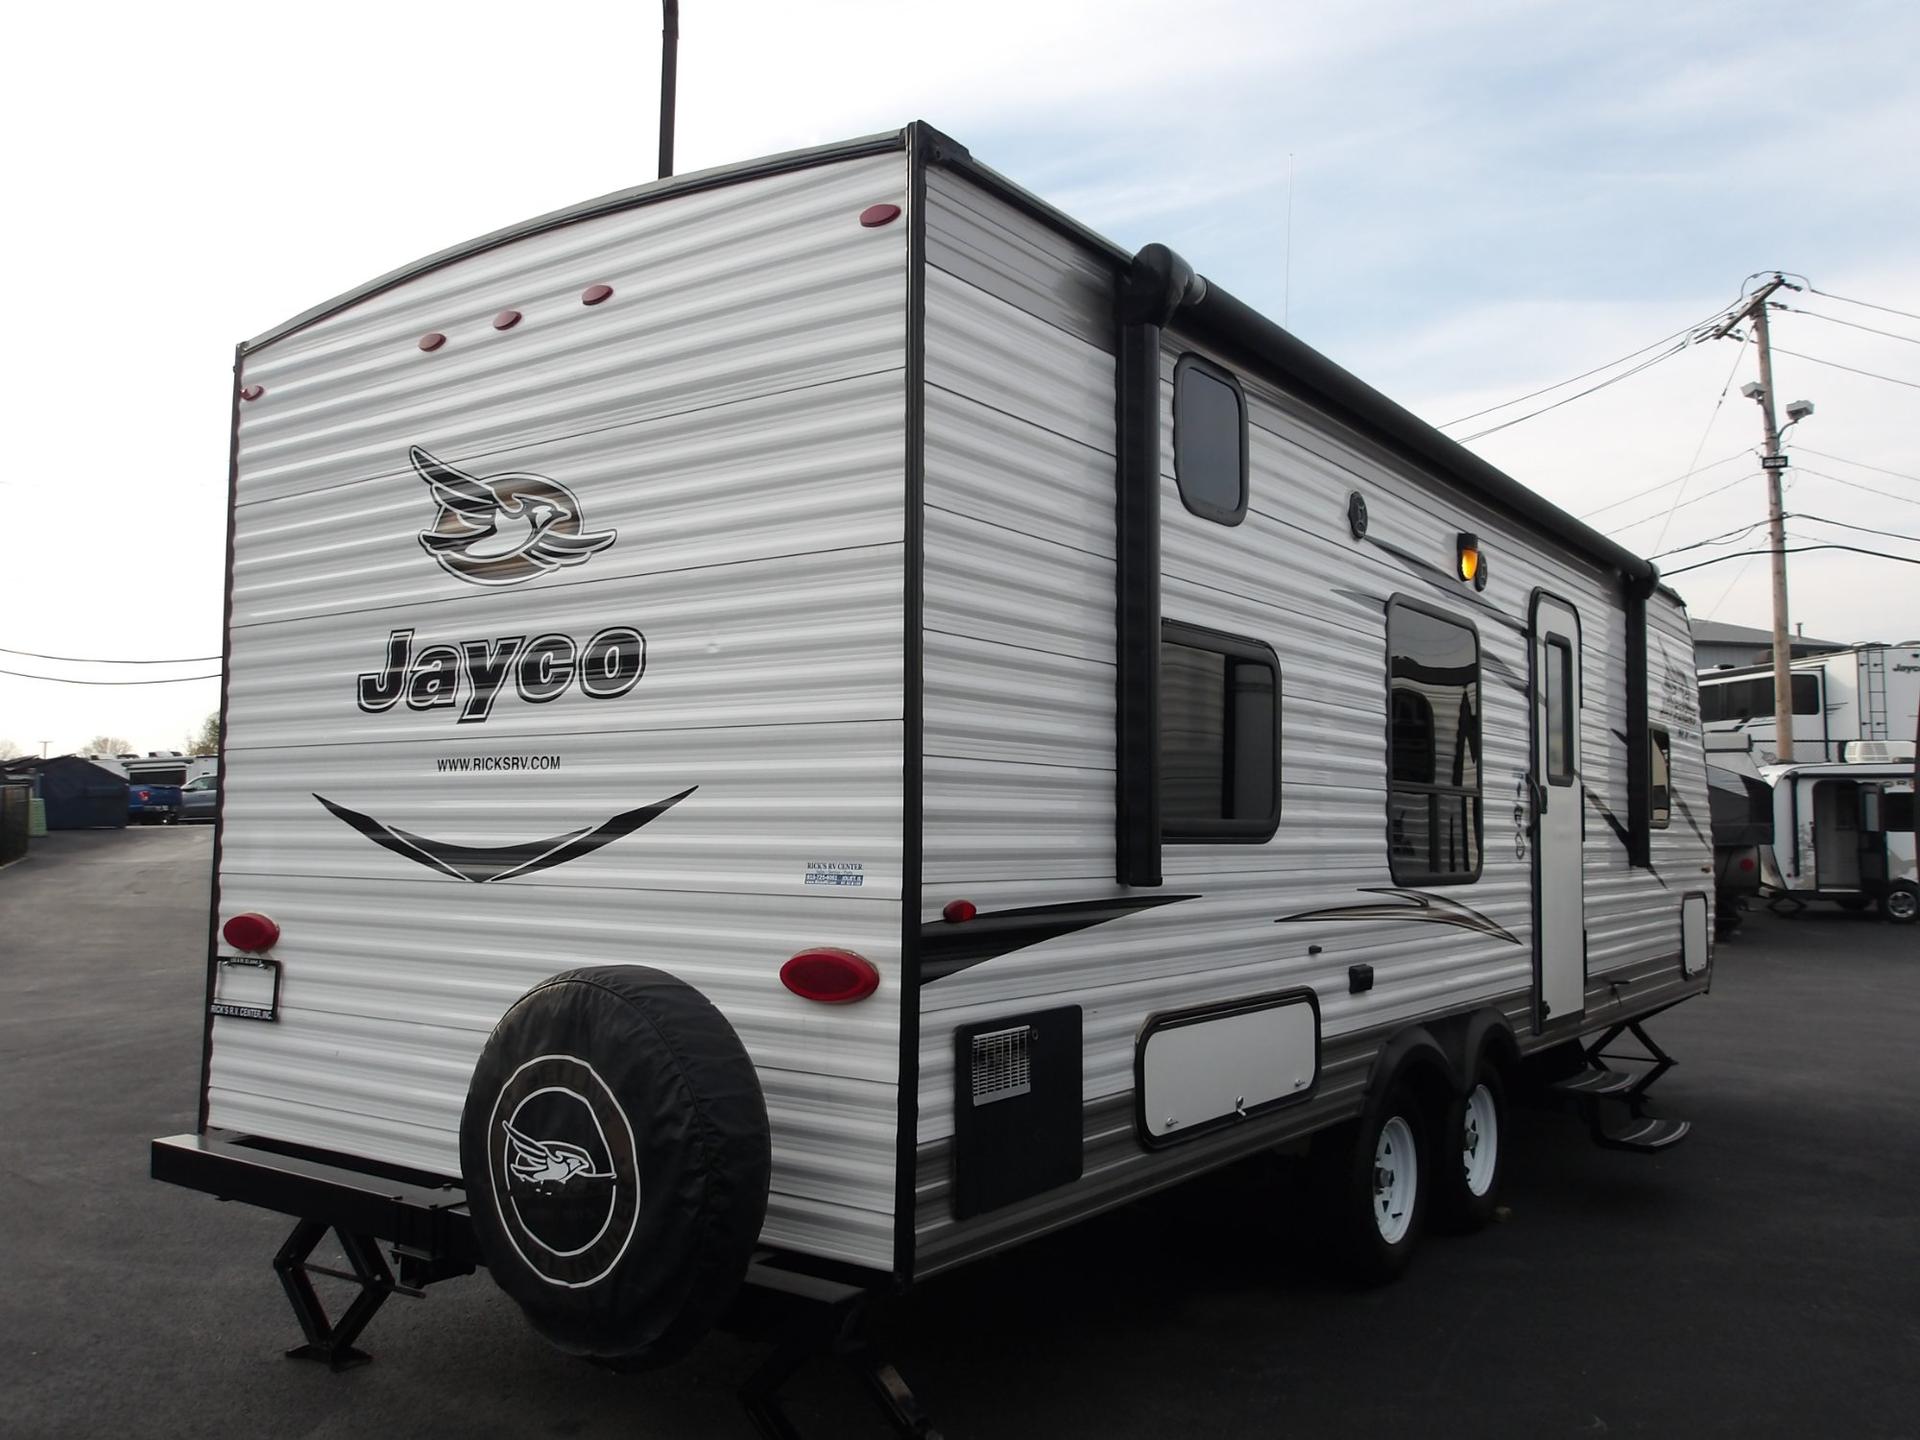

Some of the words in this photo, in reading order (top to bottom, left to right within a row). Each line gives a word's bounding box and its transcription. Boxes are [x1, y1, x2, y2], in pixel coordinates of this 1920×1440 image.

[357, 626, 647, 724] Jayco
[437, 756, 561, 772] WWW.RICKSRV.COM
[807, 862, 827, 870] RICK'S
